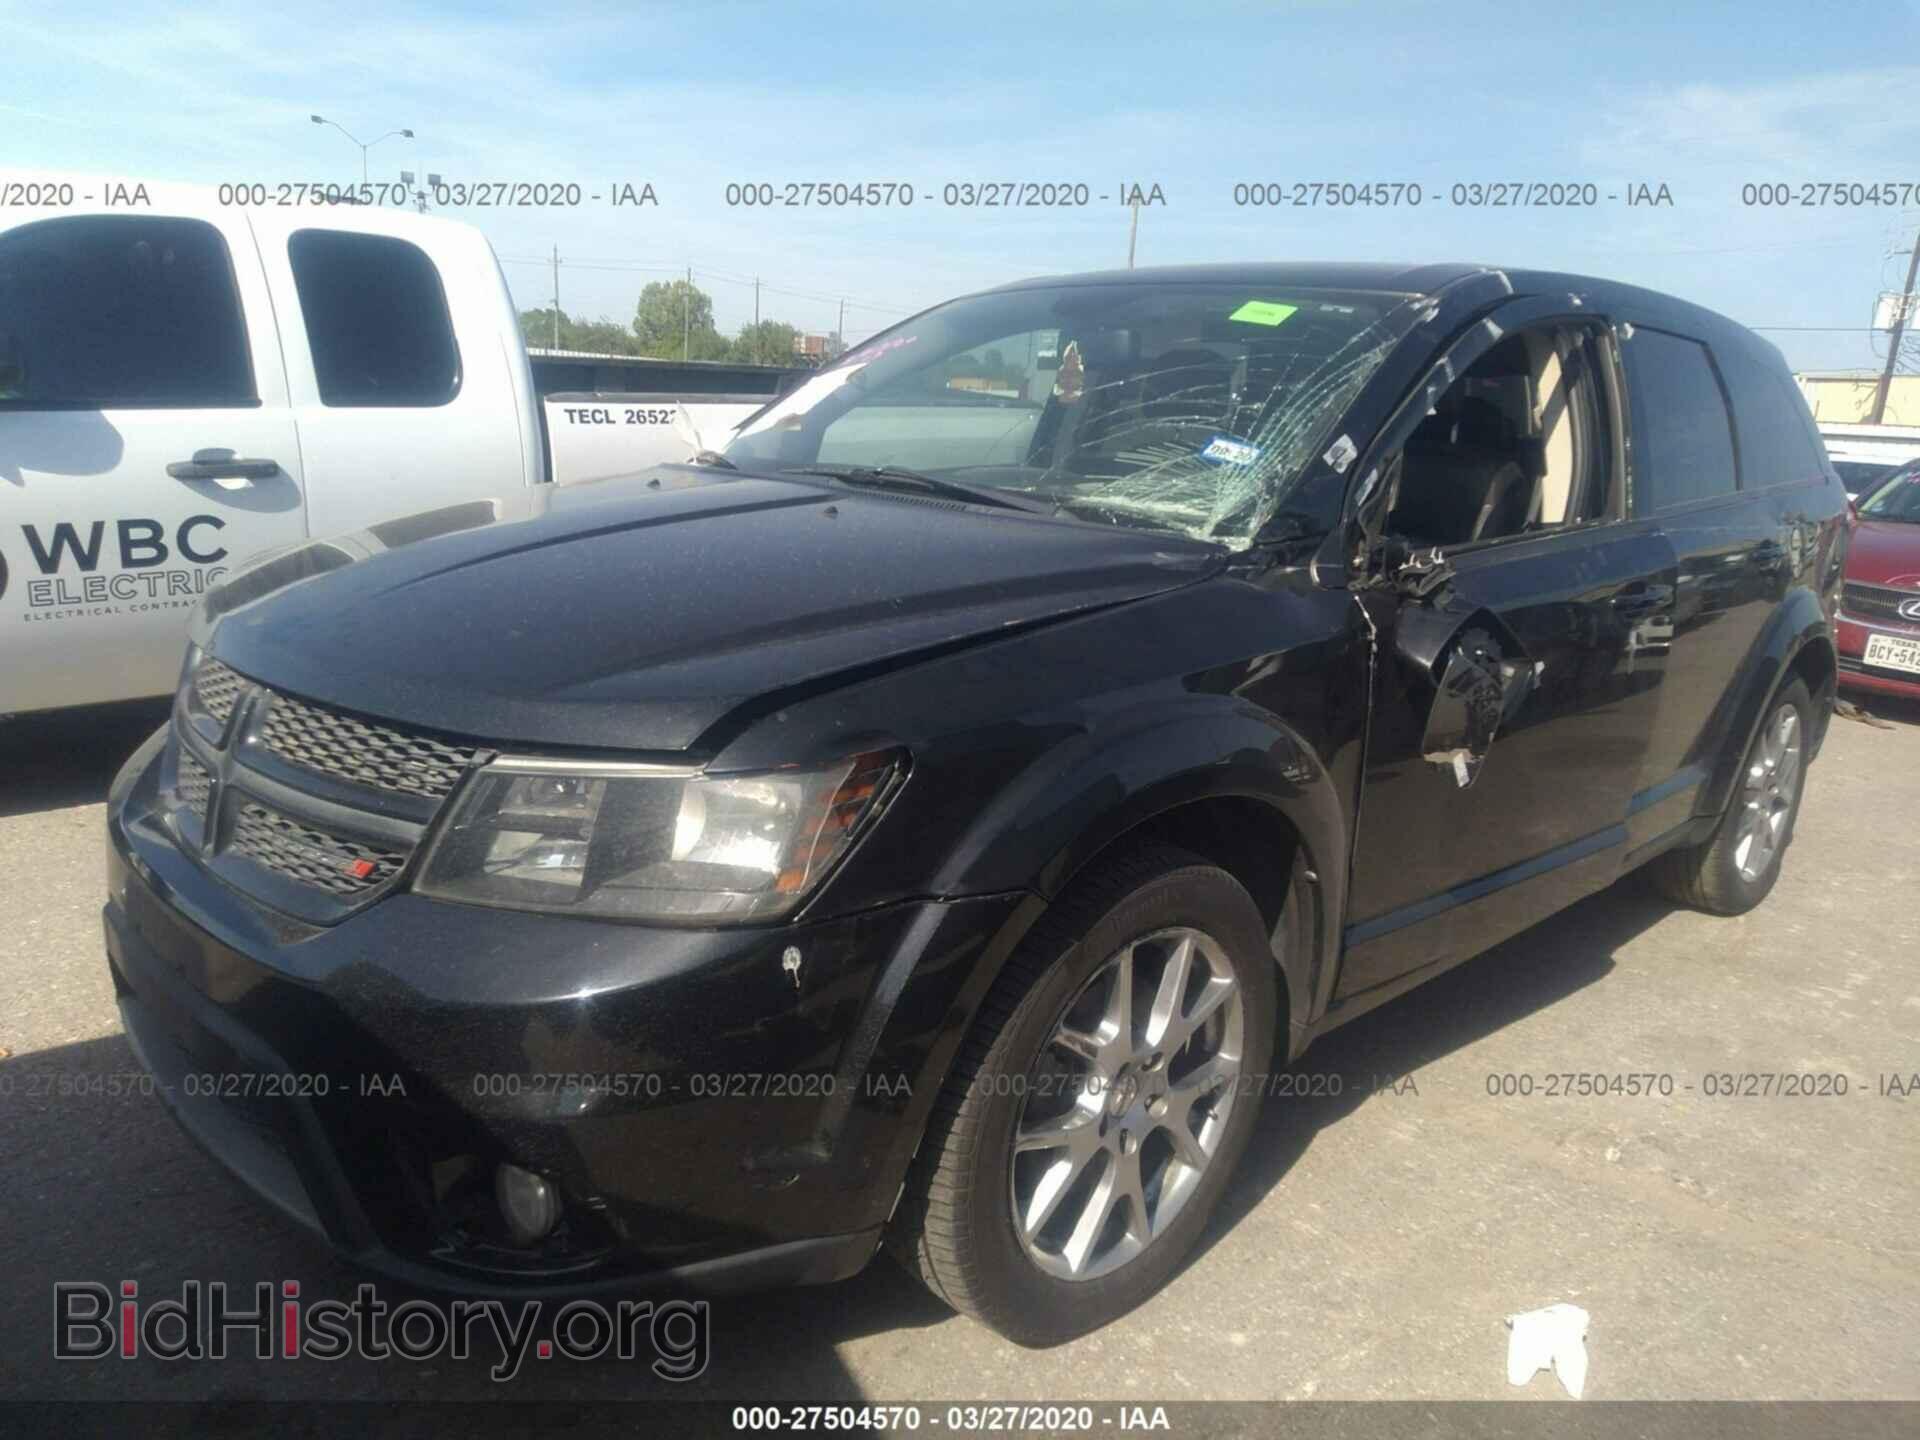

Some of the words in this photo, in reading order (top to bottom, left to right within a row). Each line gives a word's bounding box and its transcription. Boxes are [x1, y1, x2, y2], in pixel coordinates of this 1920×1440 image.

[564, 409, 616, 424] TECL
[21, 514, 229, 574] WBC
[23, 606, 122, 622] ELECTRICAL
